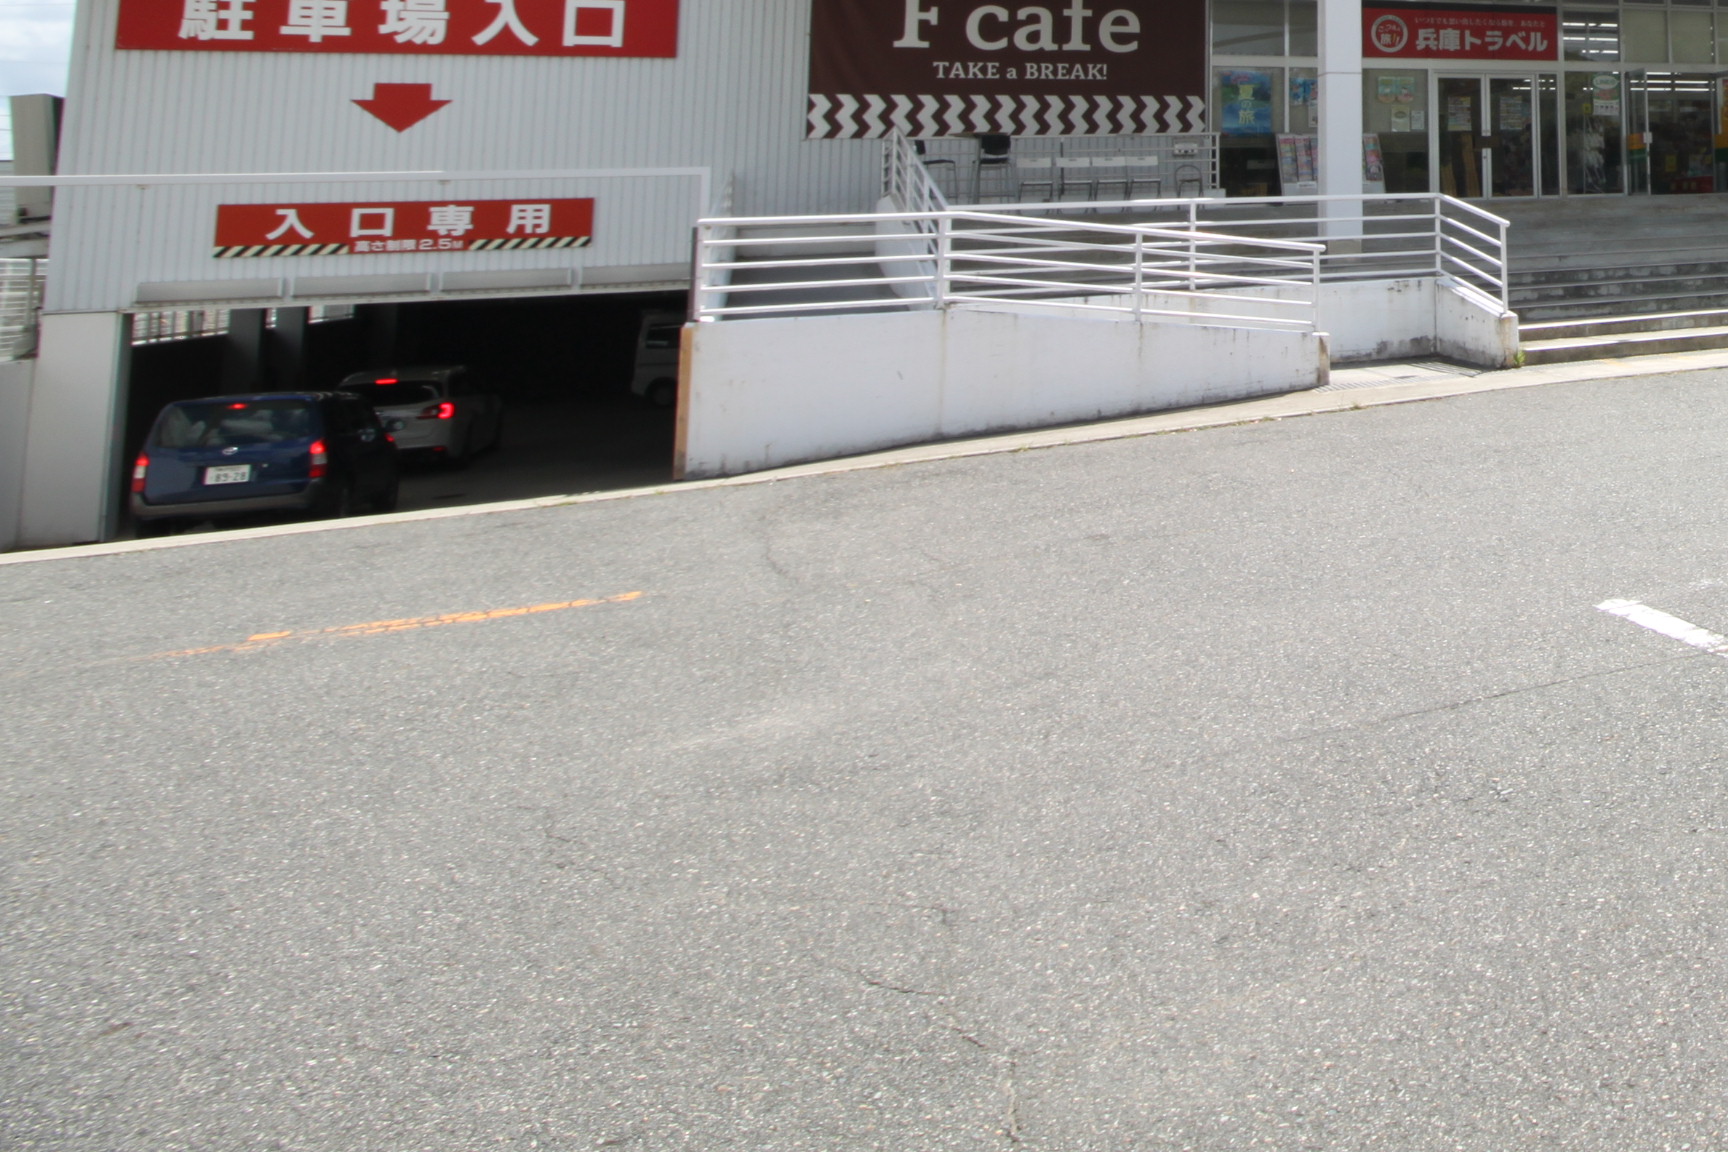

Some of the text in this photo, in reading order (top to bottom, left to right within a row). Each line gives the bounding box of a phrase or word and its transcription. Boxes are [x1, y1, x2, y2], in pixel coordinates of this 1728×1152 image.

[1415, 28, 1548, 52] 兵庫トラベル
[933, 61, 1108, 81] TAKE a BREAK!
[265, 203, 552, 241] 入口専用
